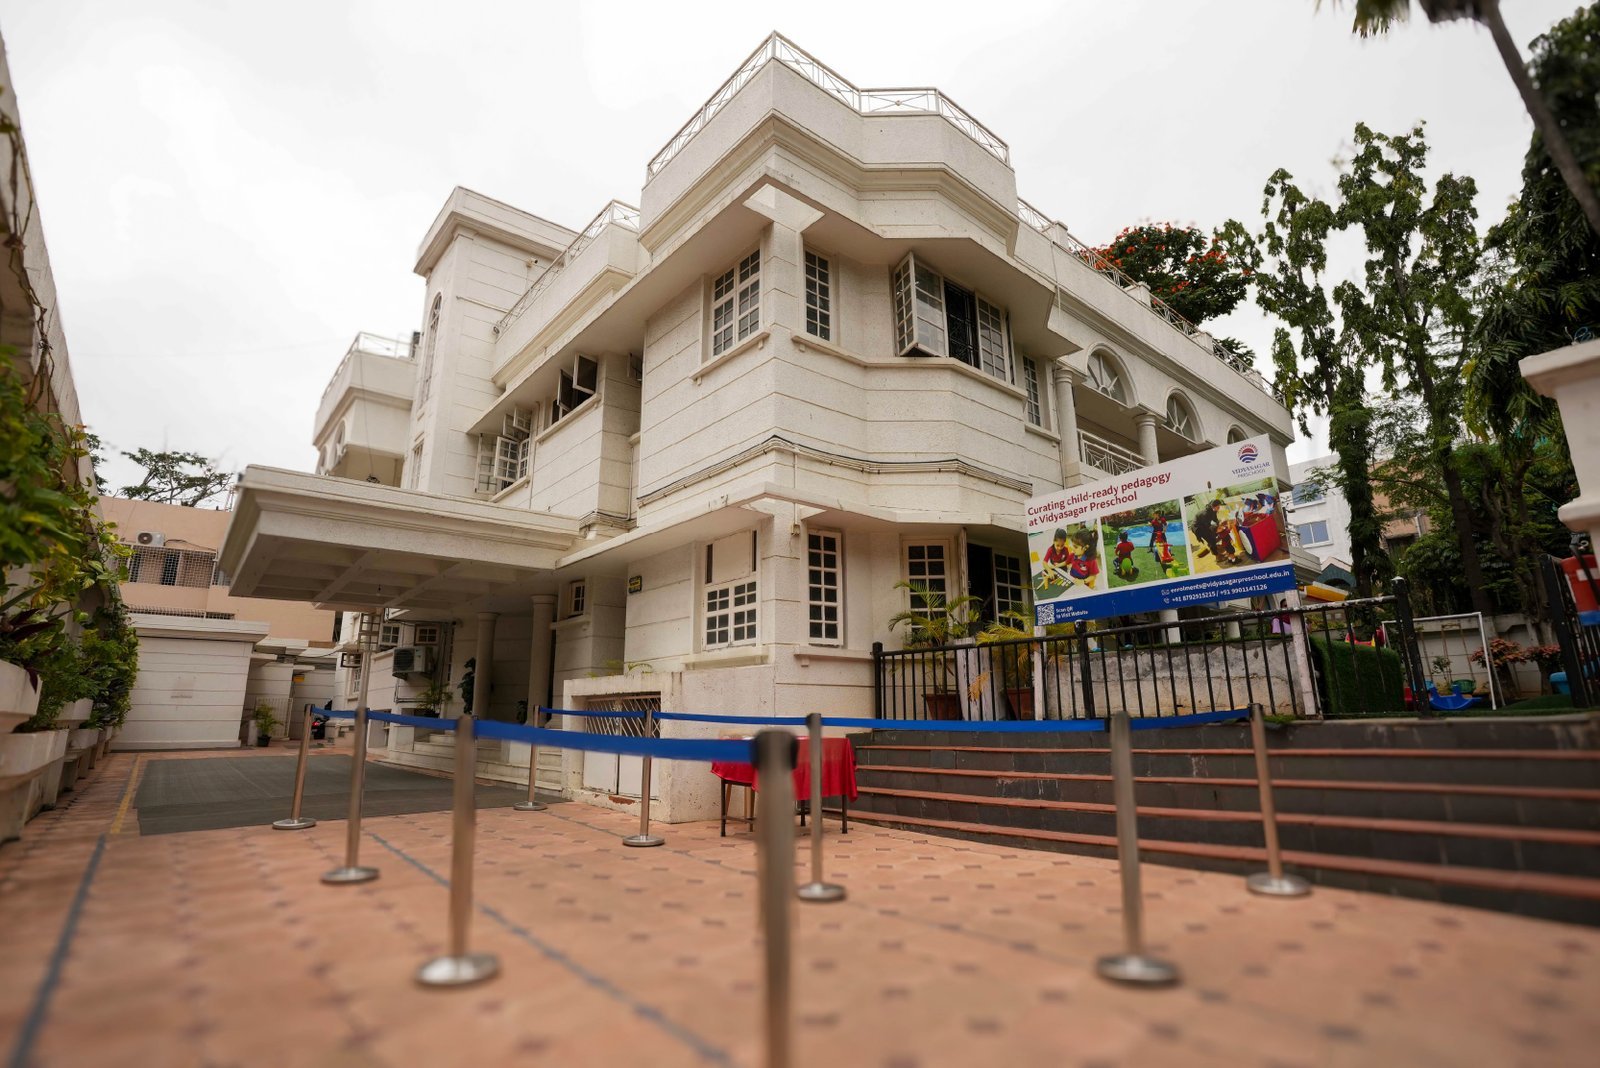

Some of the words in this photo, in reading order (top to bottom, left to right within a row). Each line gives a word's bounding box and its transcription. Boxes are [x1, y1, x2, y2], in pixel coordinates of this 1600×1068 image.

[1027, 500, 1065, 516] Curating
[1066, 485, 1119, 506] child-ready
[1121, 472, 1171, 492] pedagogy
[1028, 518, 1038, 527] at
[1039, 506, 1088, 524] Vidyasagar
[1090, 491, 1138, 512] Preschool
[1220, 588, 1231, 596] +91
